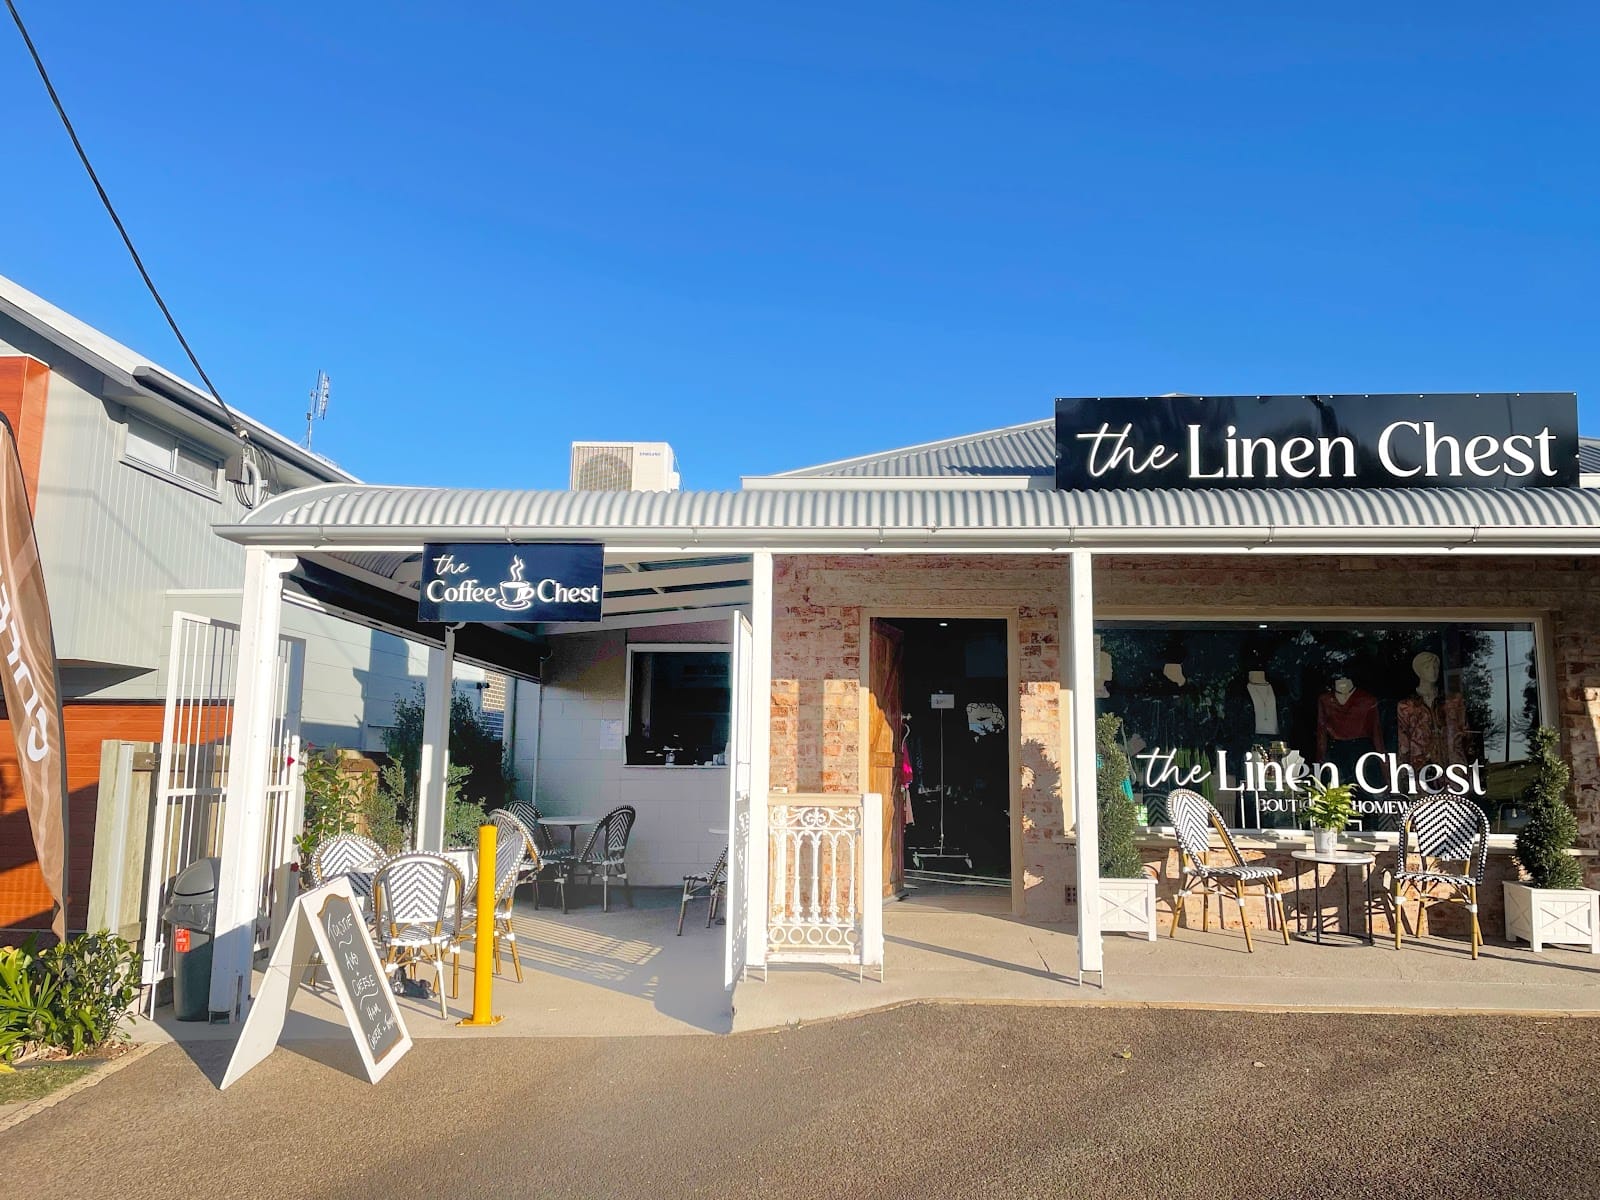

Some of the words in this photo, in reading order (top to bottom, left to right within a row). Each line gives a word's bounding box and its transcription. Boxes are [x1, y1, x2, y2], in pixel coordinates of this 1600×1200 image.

[1076, 422, 1178, 478] the
[1188, 424, 1356, 478] Linen
[1378, 420, 1558, 478] Chest
[432, 554, 470, 576] the
[426, 579, 497, 603] Coffee
[537, 579, 601, 603] Chest
[1137, 747, 1211, 788] the
[1217, 750, 1340, 792] Linen
[1355, 751, 1487, 796] Chest
